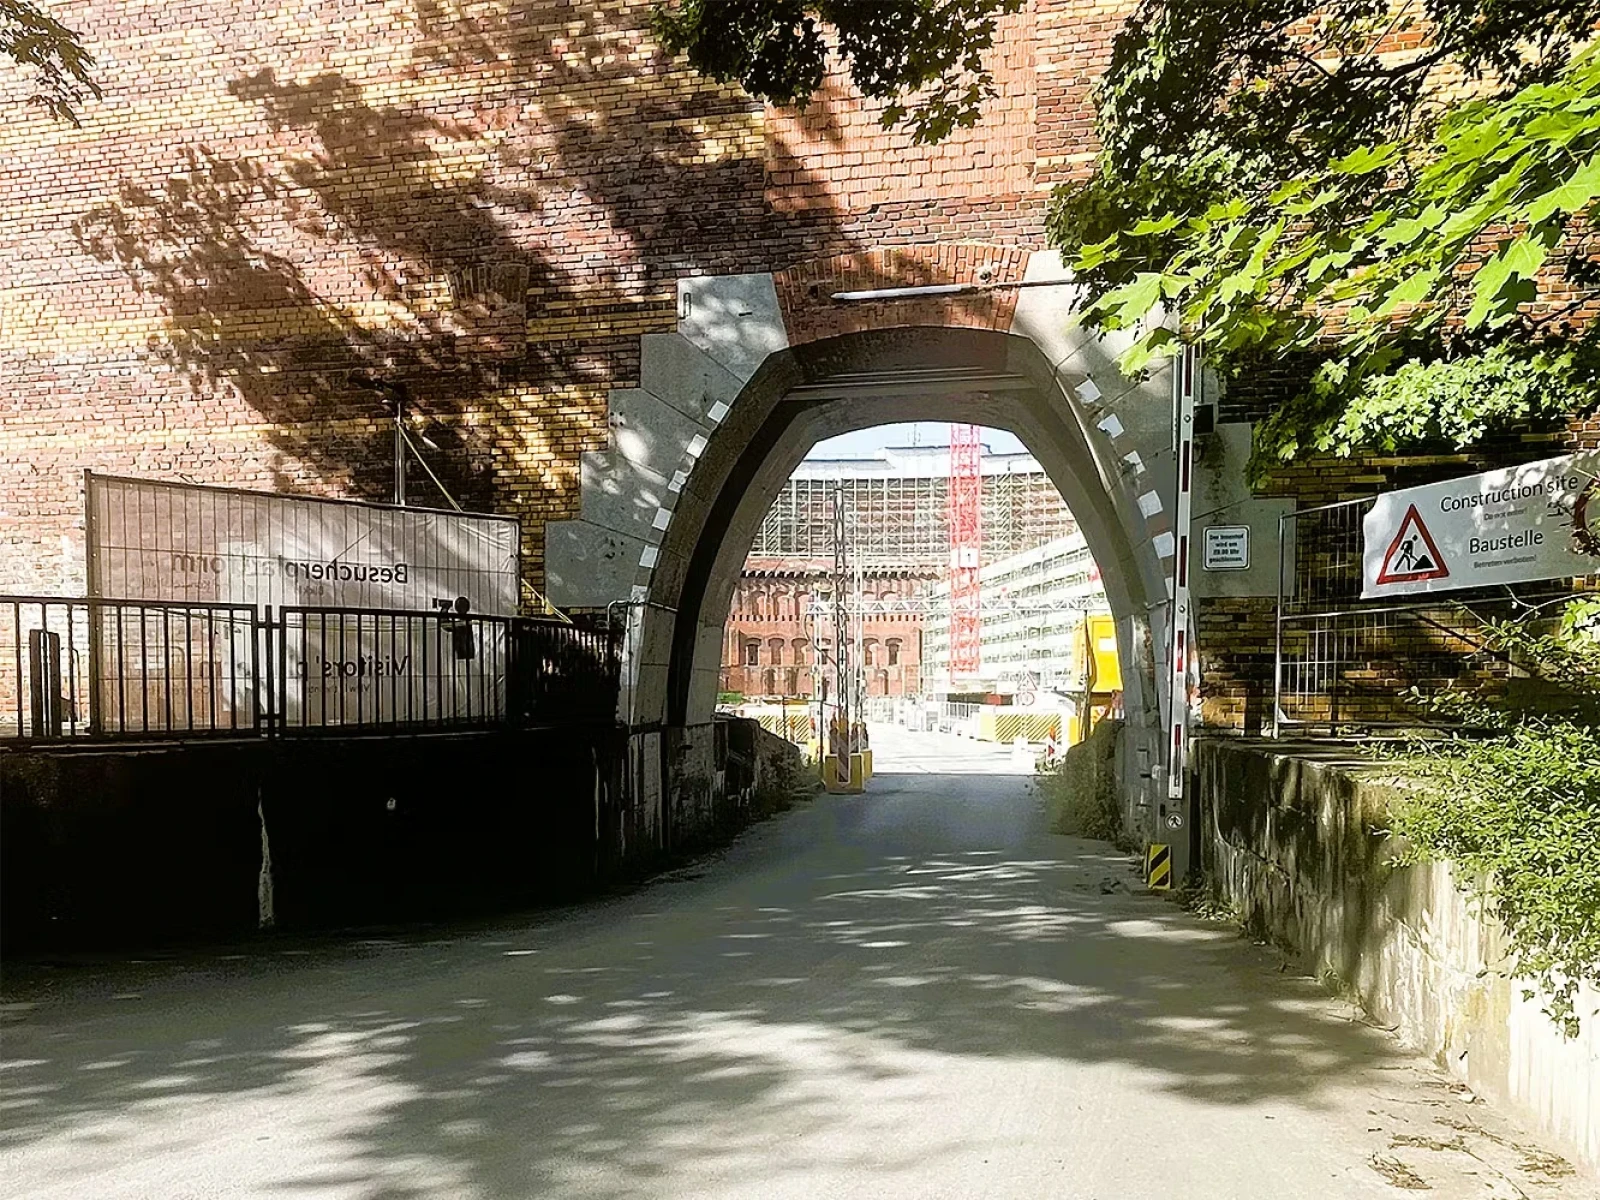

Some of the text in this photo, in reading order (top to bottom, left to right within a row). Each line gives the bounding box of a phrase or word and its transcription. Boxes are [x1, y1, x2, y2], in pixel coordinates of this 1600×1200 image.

[1440, 475, 1578, 512] Construction site
[1469, 530, 1544, 554] Baustelle
